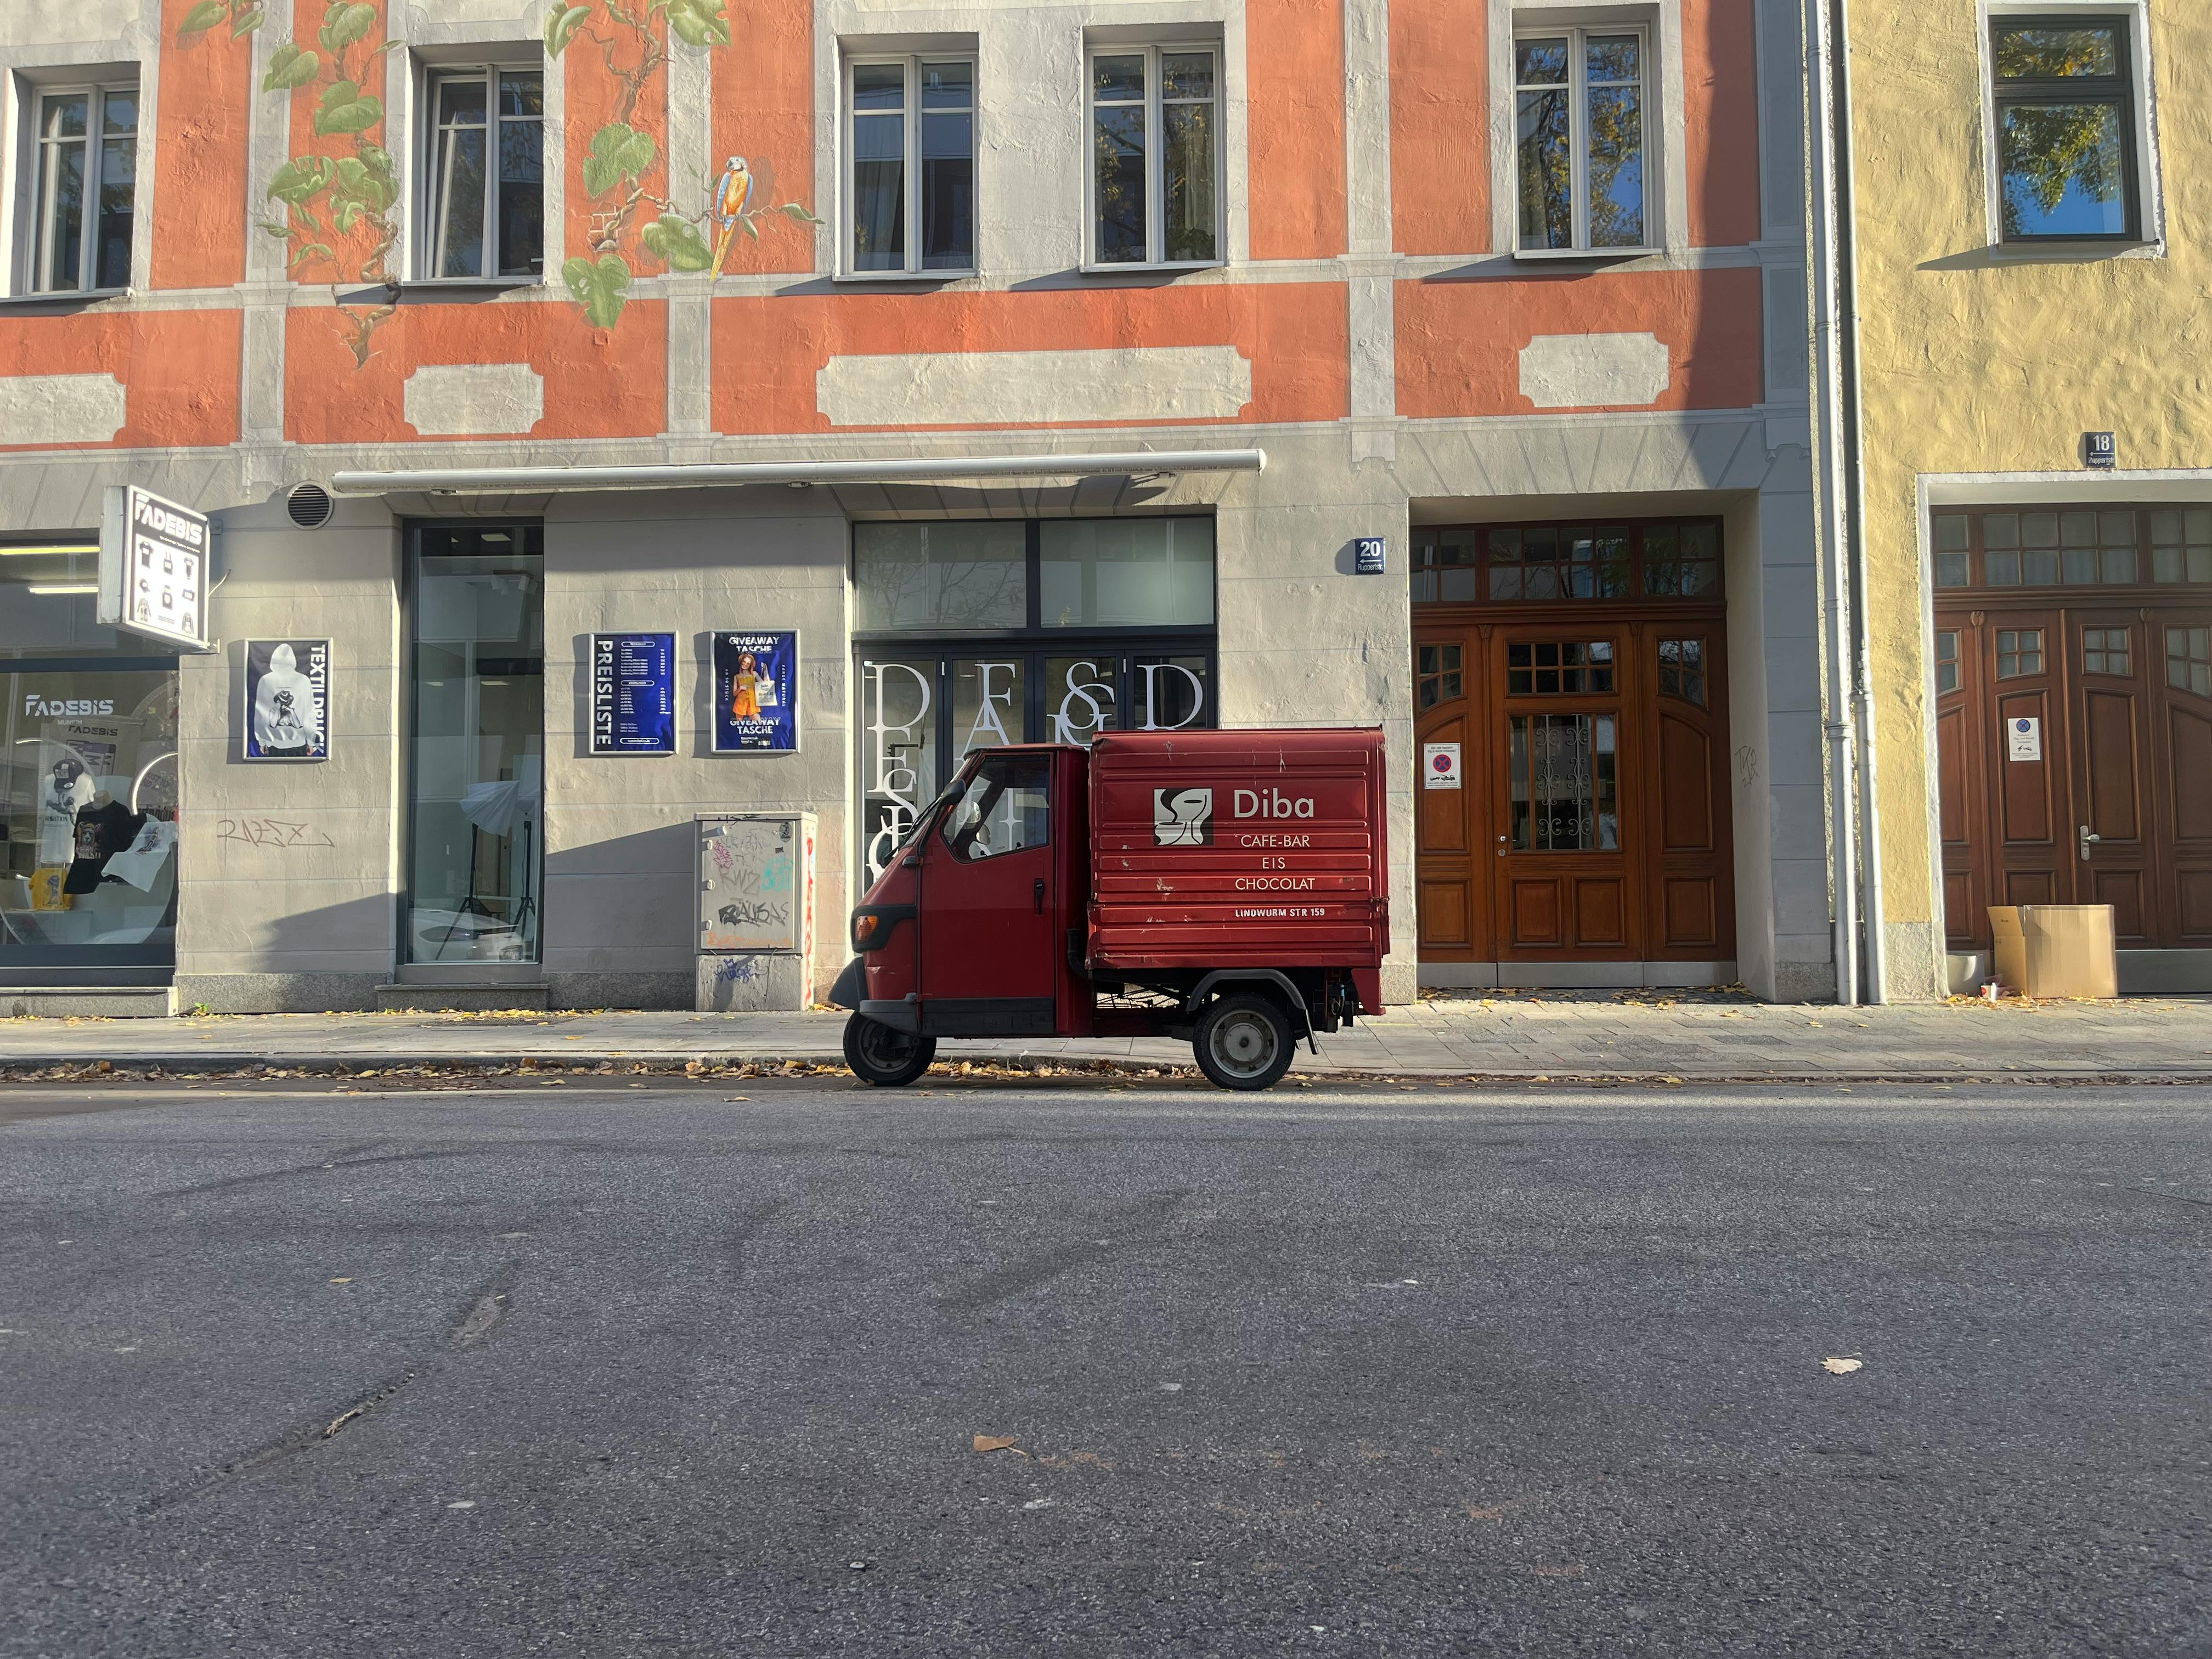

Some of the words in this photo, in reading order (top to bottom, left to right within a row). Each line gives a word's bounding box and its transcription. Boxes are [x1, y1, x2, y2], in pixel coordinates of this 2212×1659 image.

[2093, 435, 2109, 451] 18
[135, 493, 202, 545] FADEBIS
[1360, 541, 1380, 557] 20
[729, 636, 780, 645] GIVEAWAY
[736, 646, 772, 654] TASCHE
[596, 641, 613, 744] PREISLISTE
[25, 695, 114, 716] FADEBIS
[729, 716, 781, 726] GIVEAWAY
[737, 726, 773, 734] TASCHE
[1234, 788, 1314, 818] Diba
[1240, 835, 1310, 848] CAFE-BAR
[1262, 857, 1285, 869] EIS
[1235, 878, 1316, 890] CHOCOLAT
[1235, 909, 1286, 917] LINDWURM
[1289, 909, 1307, 917] STR
[1310, 908, 1325, 916] 159
